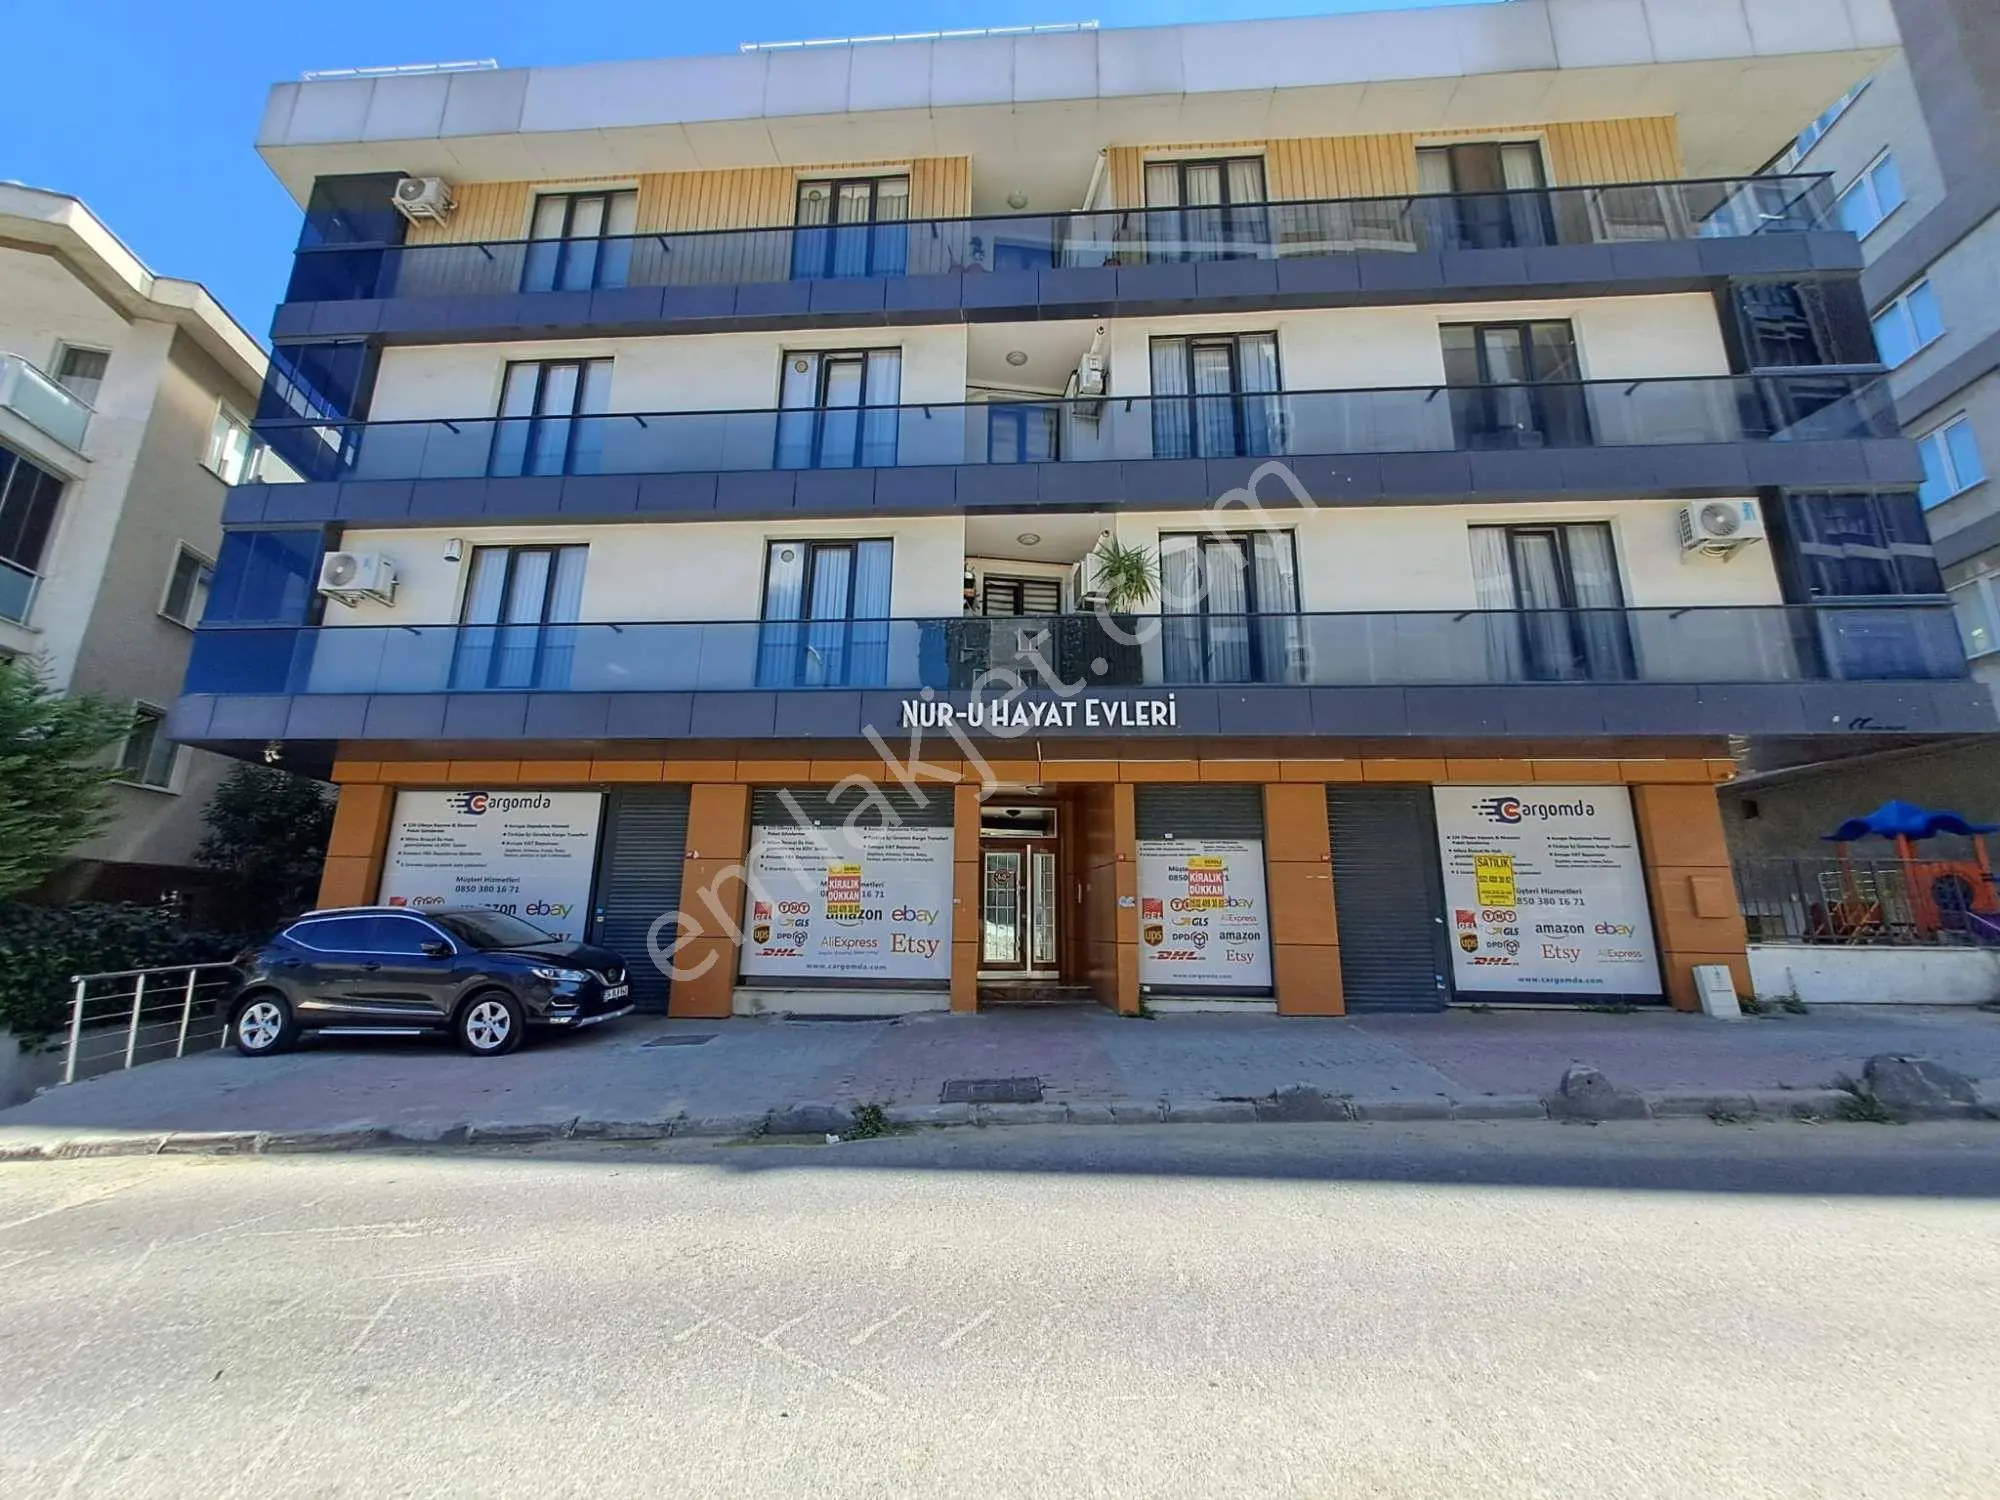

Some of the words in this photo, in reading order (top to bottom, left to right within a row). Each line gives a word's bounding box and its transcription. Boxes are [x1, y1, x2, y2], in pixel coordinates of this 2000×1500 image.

[991, 699, 1077, 727] HAYAT
[1085, 693, 1177, 727] EVLERİ
[1495, 797, 1595, 824] Cargomda
[1477, 857, 1510, 869] SATILIK
[1190, 871, 1223, 883] KİRALIK
[829, 878, 859, 889] KİRALIK
[861, 881, 884, 889] metleri
[828, 890, 859, 901] DÜKKAN
[1190, 884, 1223, 896] DÜKKAN
[1516, 887, 1539, 896] üşteri
[1541, 887, 1582, 896] Hizmetleri
[778, 901, 811, 914] TNT
[1517, 898, 1535, 906] 850
[1538, 898, 1556, 906] 380
[1558, 898, 1570, 906] 16
[1573, 899, 1585, 907] 71
[526, 899, 574, 920] ebay
[891, 905, 939, 926] ebay
[1192, 917, 1209, 926] GLS
[1482, 910, 1517, 922] TNT
[795, 919, 810, 927] GLS
[1535, 923, 1585, 934] amazon
[755, 927, 770, 941] ups
[1503, 927, 1519, 936] GLS
[1595, 921, 1635, 938] ebay
[1145, 929, 1163, 943] ups
[1172, 933, 1190, 941] DPD
[1219, 931, 1261, 941] amazon
[821, 936, 878, 949] AliExpress
[891, 933, 940, 958] Etsy
[1461, 938, 1478, 950] ups
[1486, 941, 1503, 949] DPD
[761, 948, 798, 957] DHL
[1156, 950, 1198, 960] DHL
[1226, 949, 1255, 964] Etsy
[1541, 944, 1580, 962] Etsy
[806, 963, 887, 971] www.cargomda.com
[1473, 957, 1513, 966] DHL
